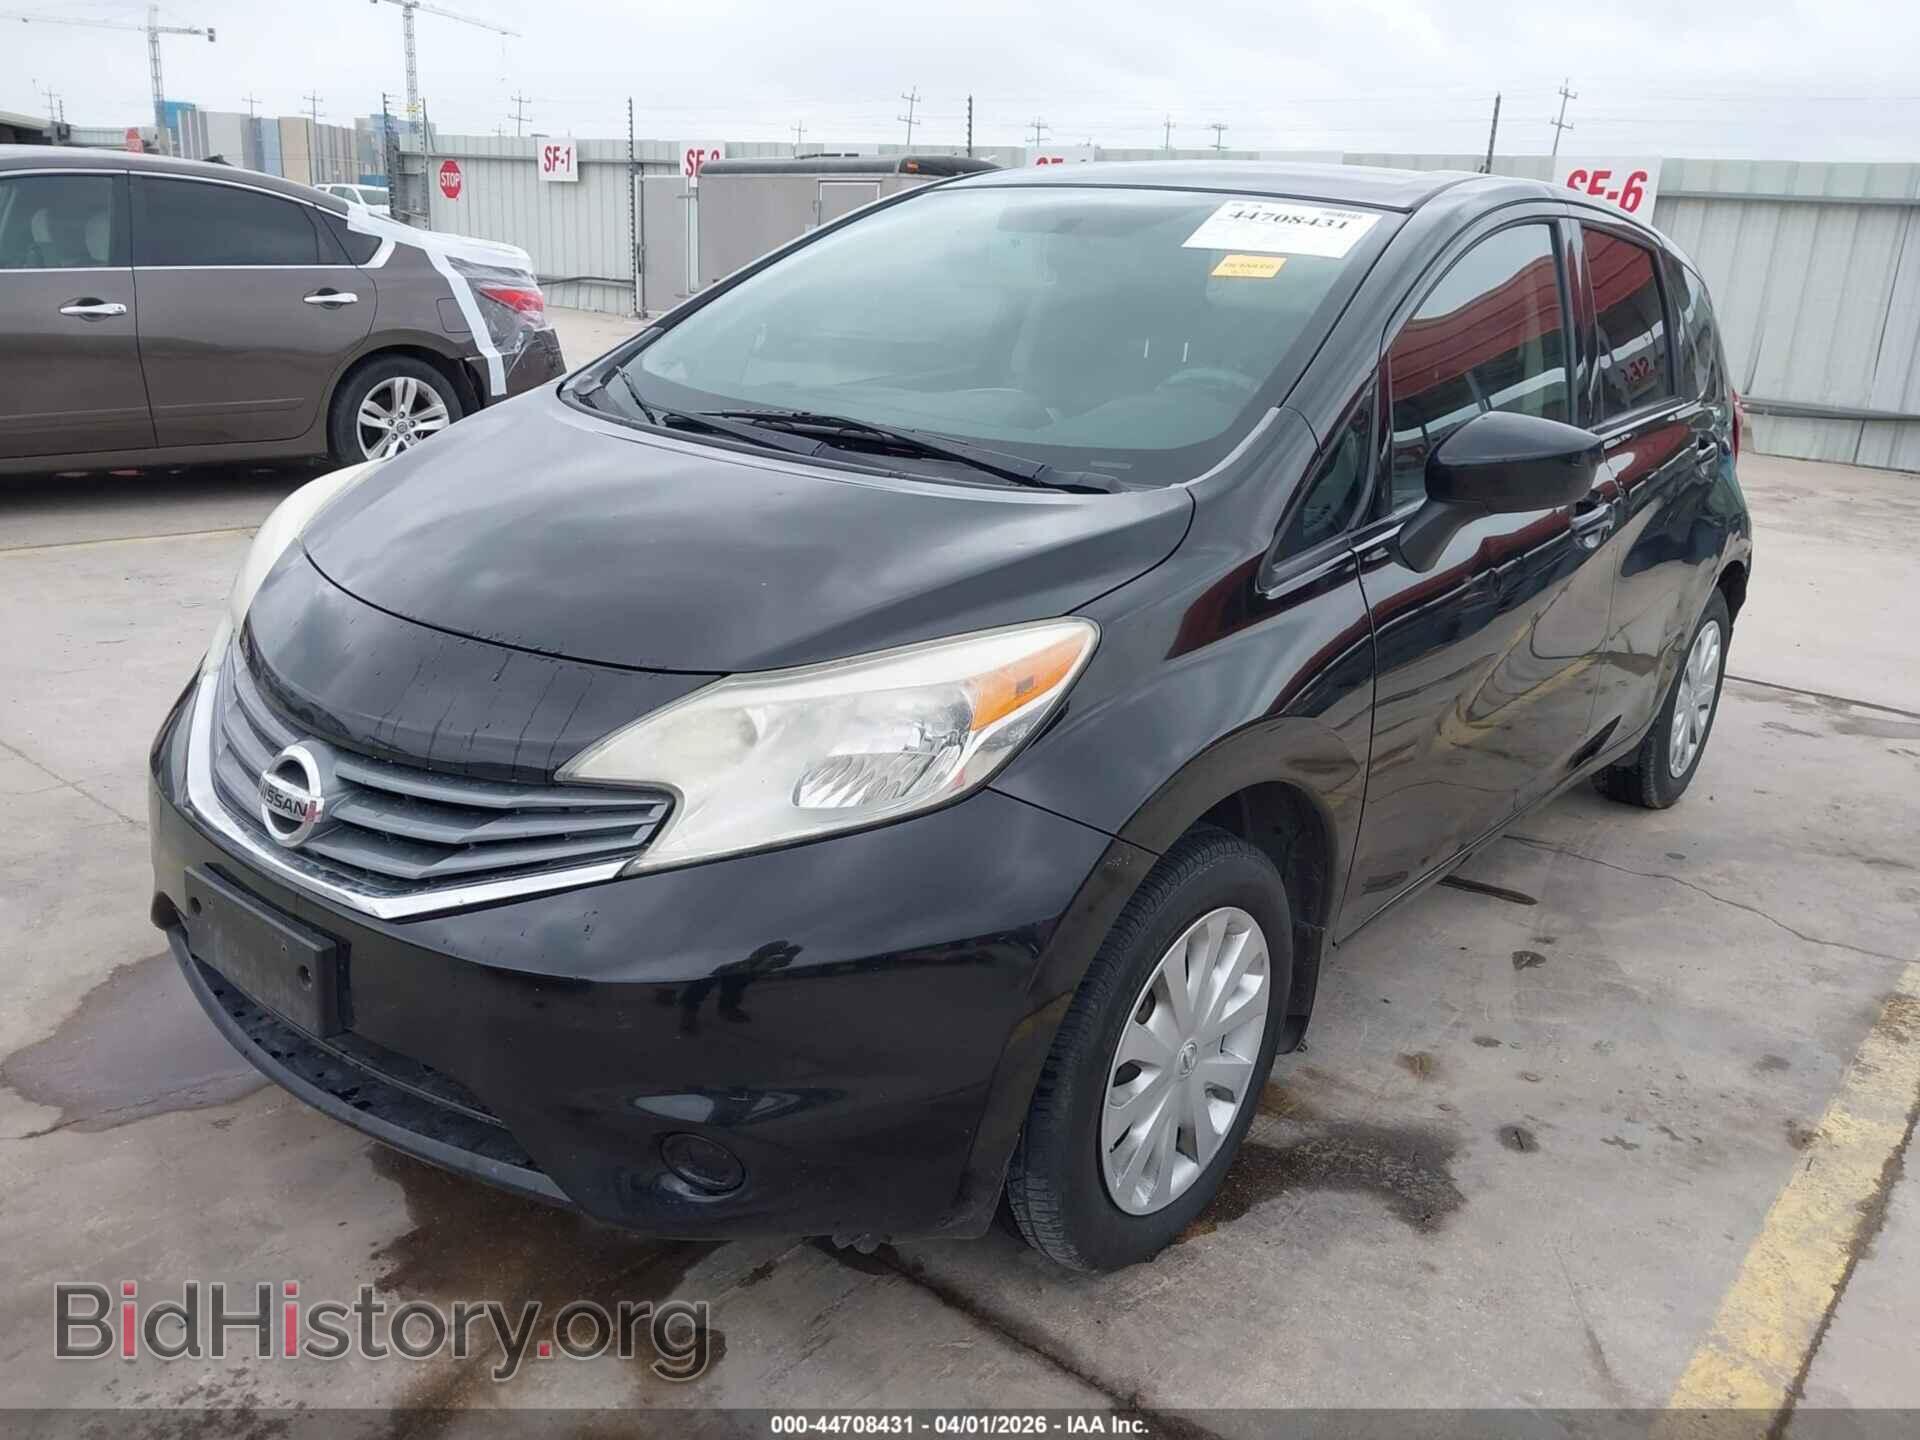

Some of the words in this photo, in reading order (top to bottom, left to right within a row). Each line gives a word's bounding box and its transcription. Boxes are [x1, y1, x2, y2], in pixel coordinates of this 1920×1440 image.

[543, 145, 571, 172] SF-1
[685, 149, 720, 177] SF
[440, 172, 460, 187] STOP
[1228, 209, 1349, 230] 44708431
[261, 782, 308, 817] NISSAN
